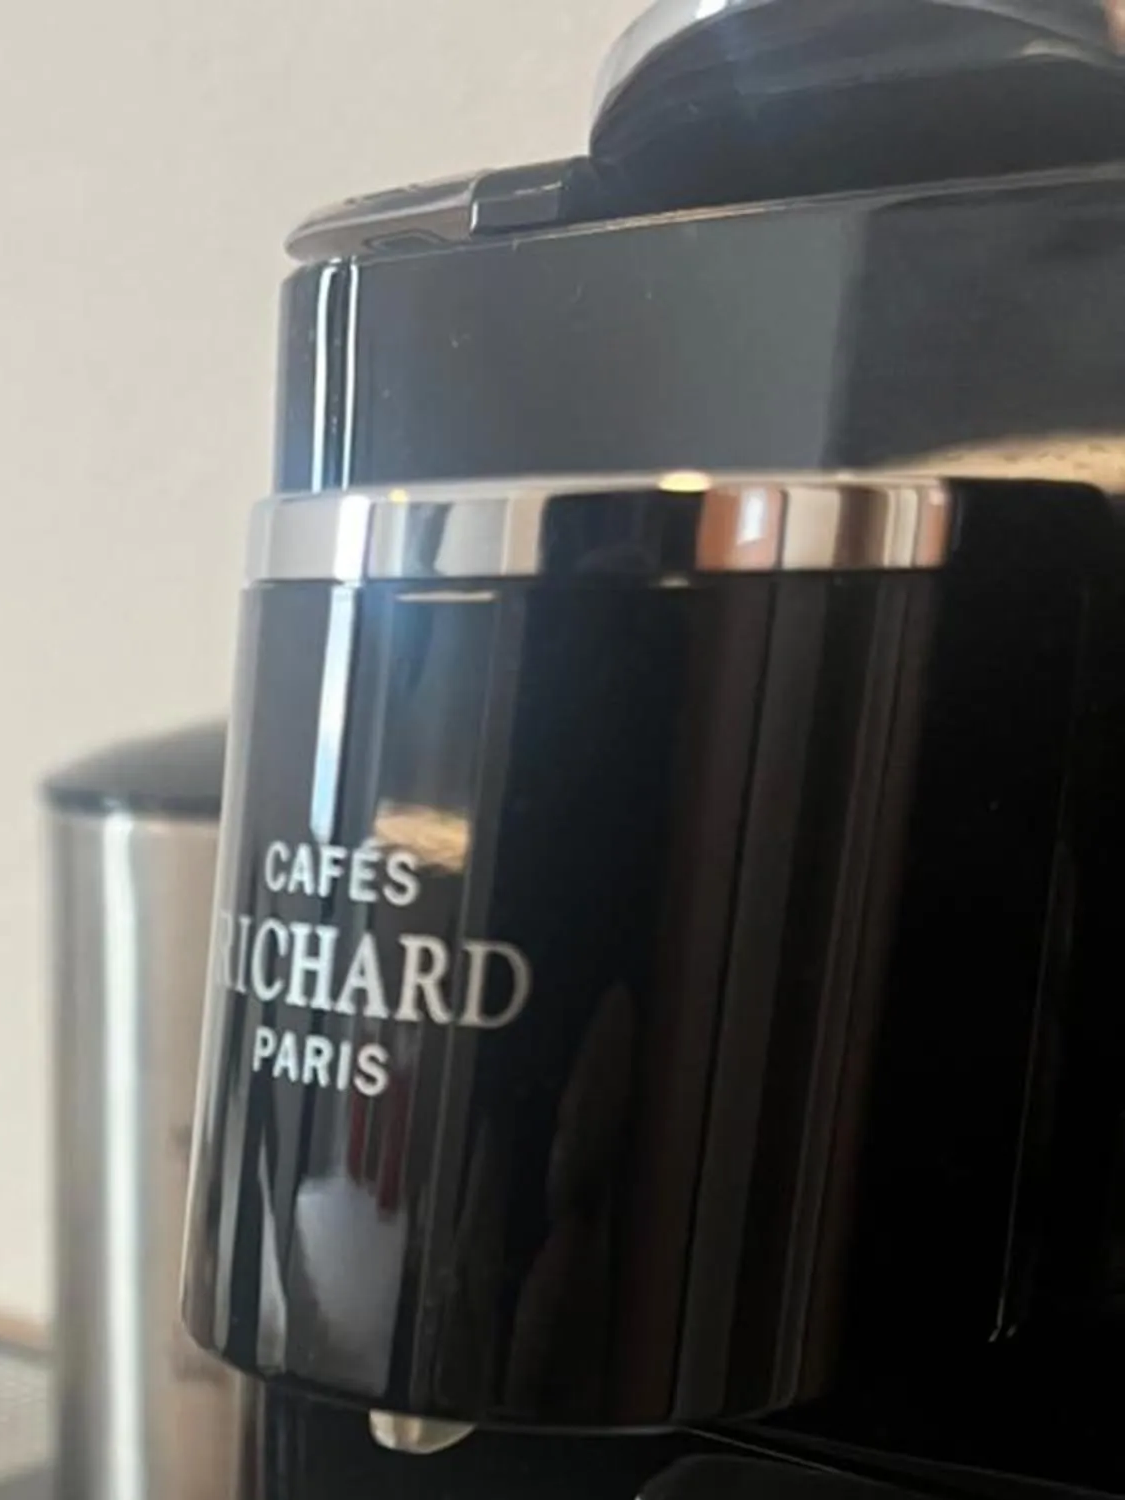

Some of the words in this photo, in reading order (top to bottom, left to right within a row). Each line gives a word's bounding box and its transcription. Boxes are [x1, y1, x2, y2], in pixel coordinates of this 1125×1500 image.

[265, 838, 421, 906] CAFÉS
[216, 910, 531, 1029] RICHARD
[252, 1027, 390, 1096] PARIS
